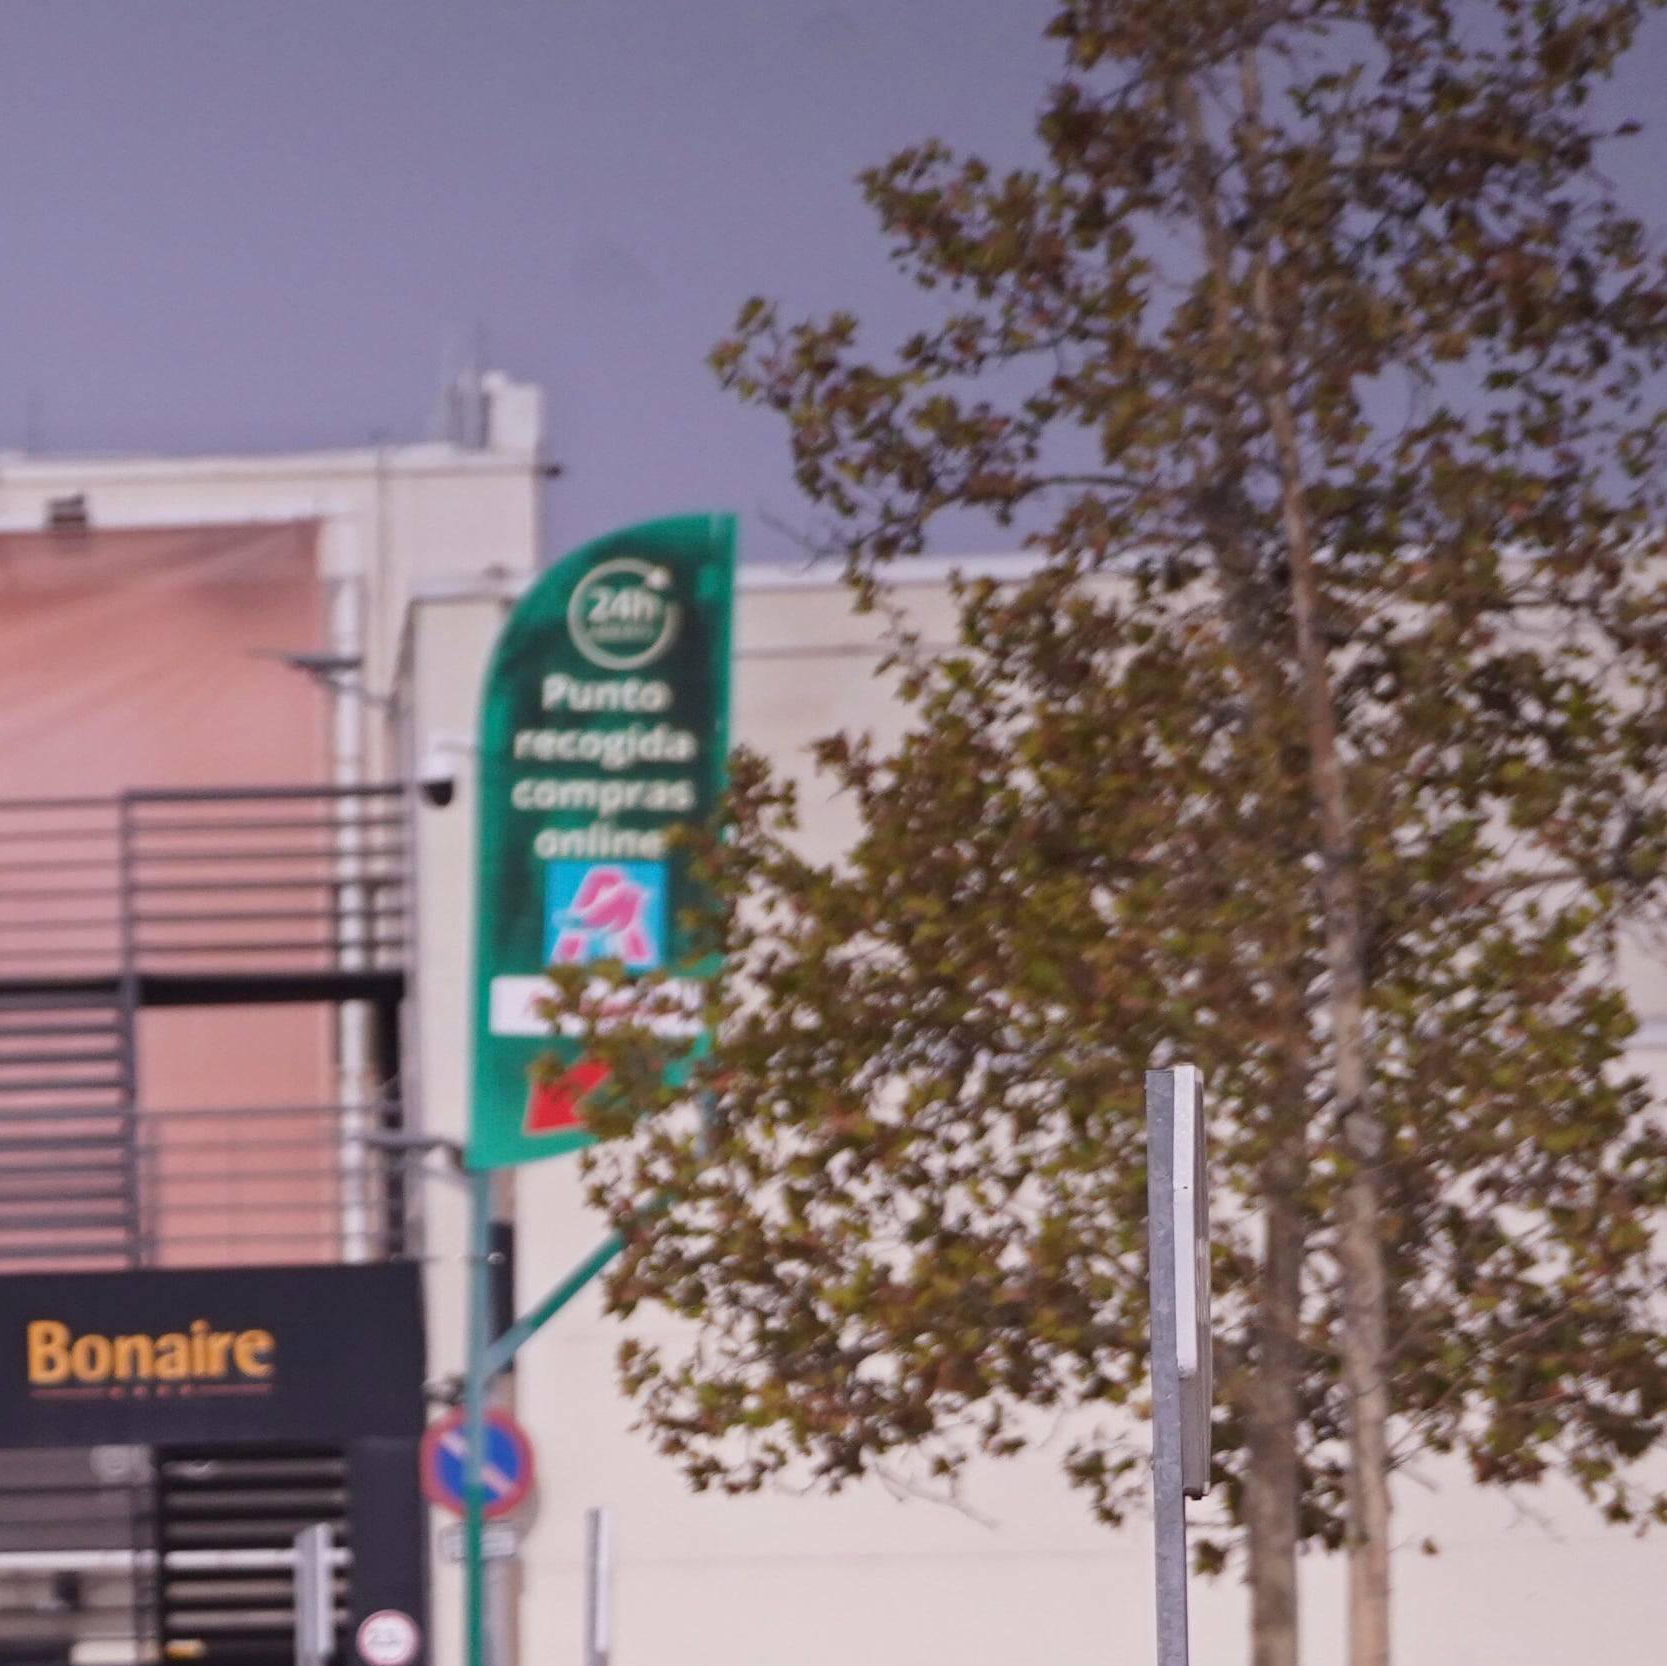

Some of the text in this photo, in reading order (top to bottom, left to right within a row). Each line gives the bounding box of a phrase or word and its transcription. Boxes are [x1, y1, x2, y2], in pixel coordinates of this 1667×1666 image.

[540, 672, 673, 713] Punto
[514, 722, 698, 770] recogida
[511, 778, 695, 818] compras
[533, 820, 667, 861] online
[26, 1318, 276, 1386] Bonaire
